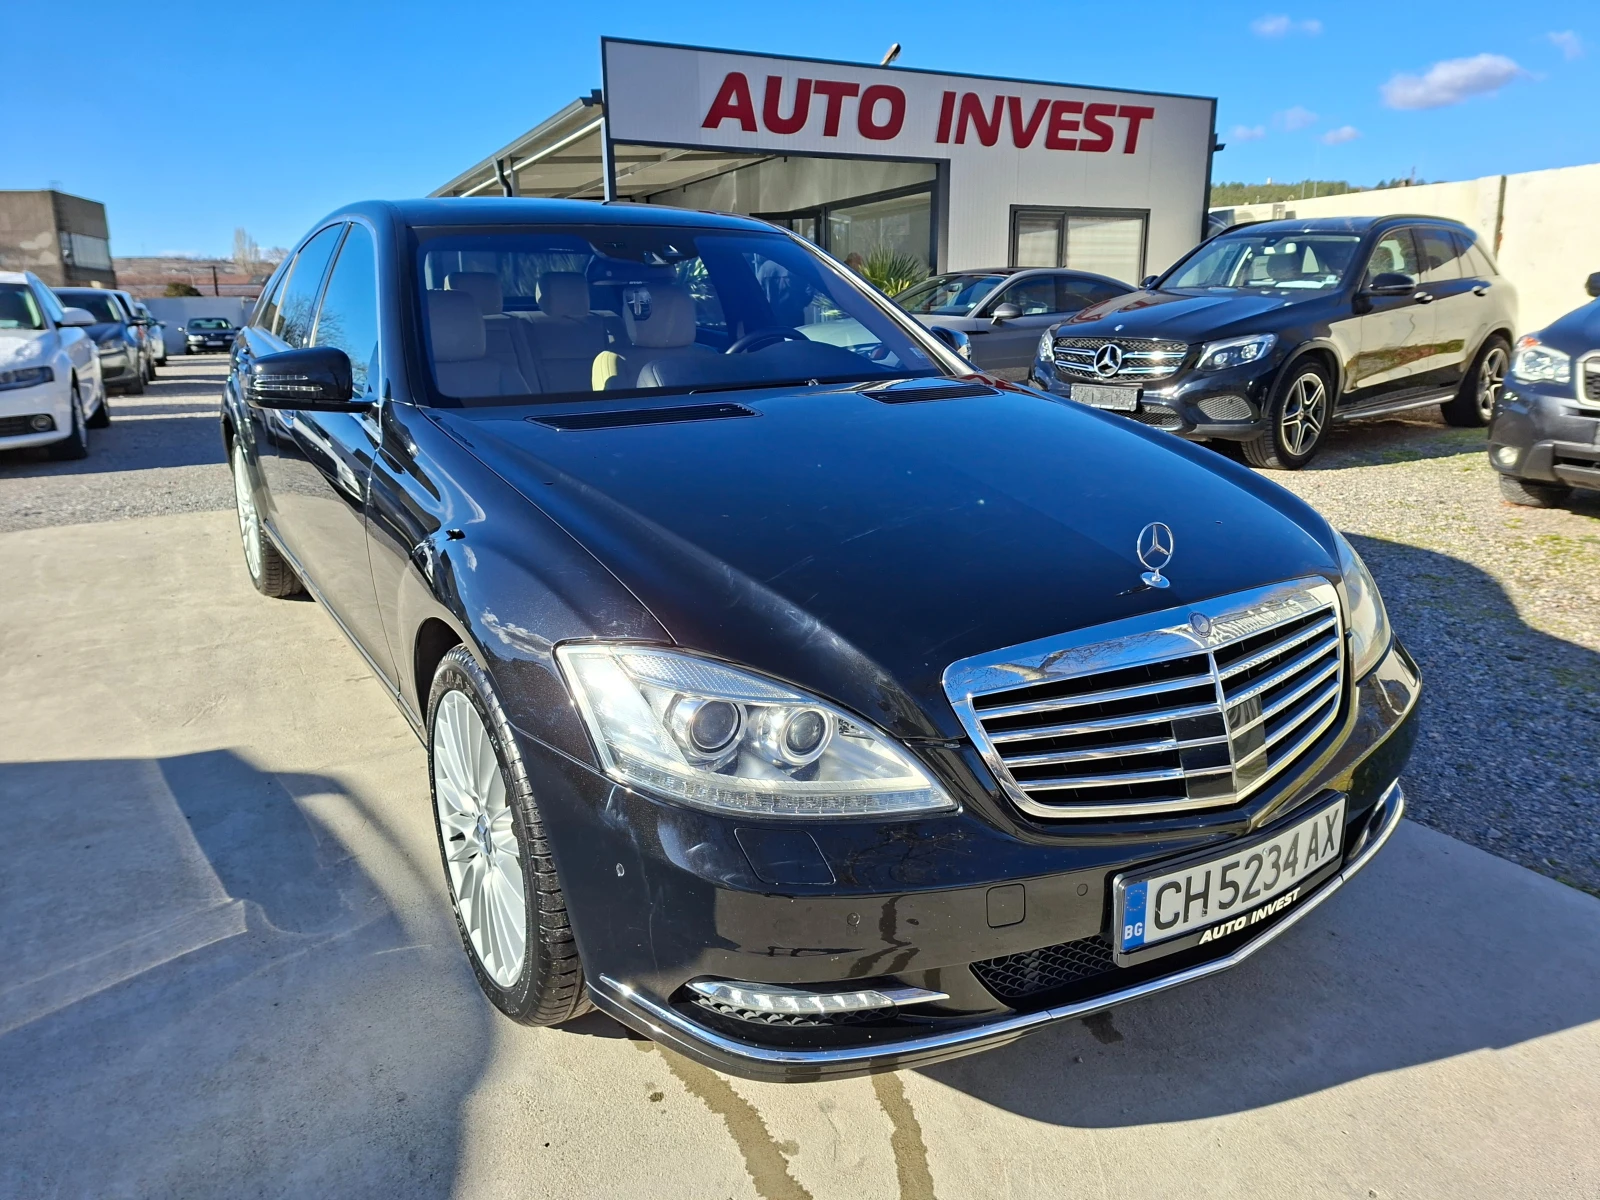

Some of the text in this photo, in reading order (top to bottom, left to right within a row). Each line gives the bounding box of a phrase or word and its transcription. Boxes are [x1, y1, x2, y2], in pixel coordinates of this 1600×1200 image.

[702, 71, 1155, 154] AUTO INVEST
[1124, 921, 1143, 940] BG
[1198, 886, 1302, 946] AUTO INVEST
